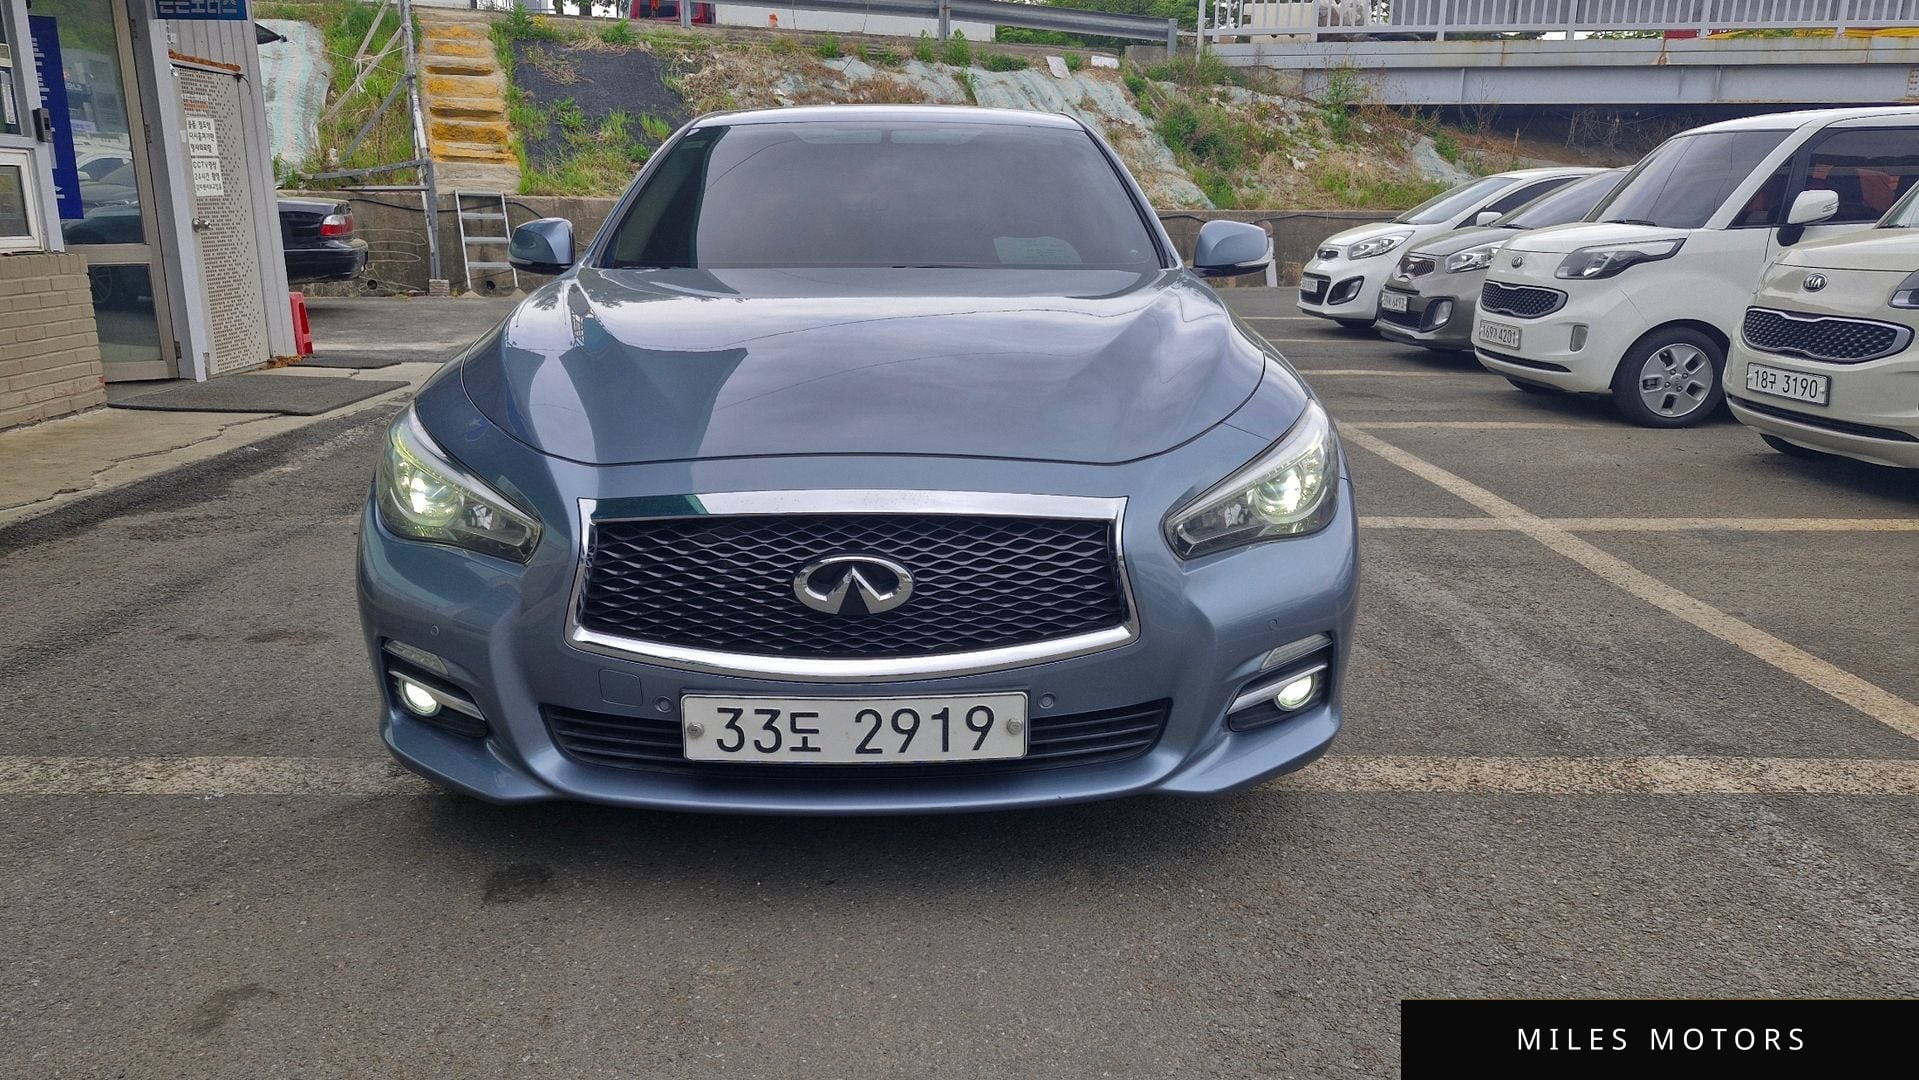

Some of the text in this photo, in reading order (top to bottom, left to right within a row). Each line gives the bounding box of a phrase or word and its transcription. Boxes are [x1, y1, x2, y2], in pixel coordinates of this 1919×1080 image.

[1498, 328, 1516, 344] 4201
[1754, 369, 1818, 398] 18구 3190
[716, 705, 995, 754] 33도 2919
